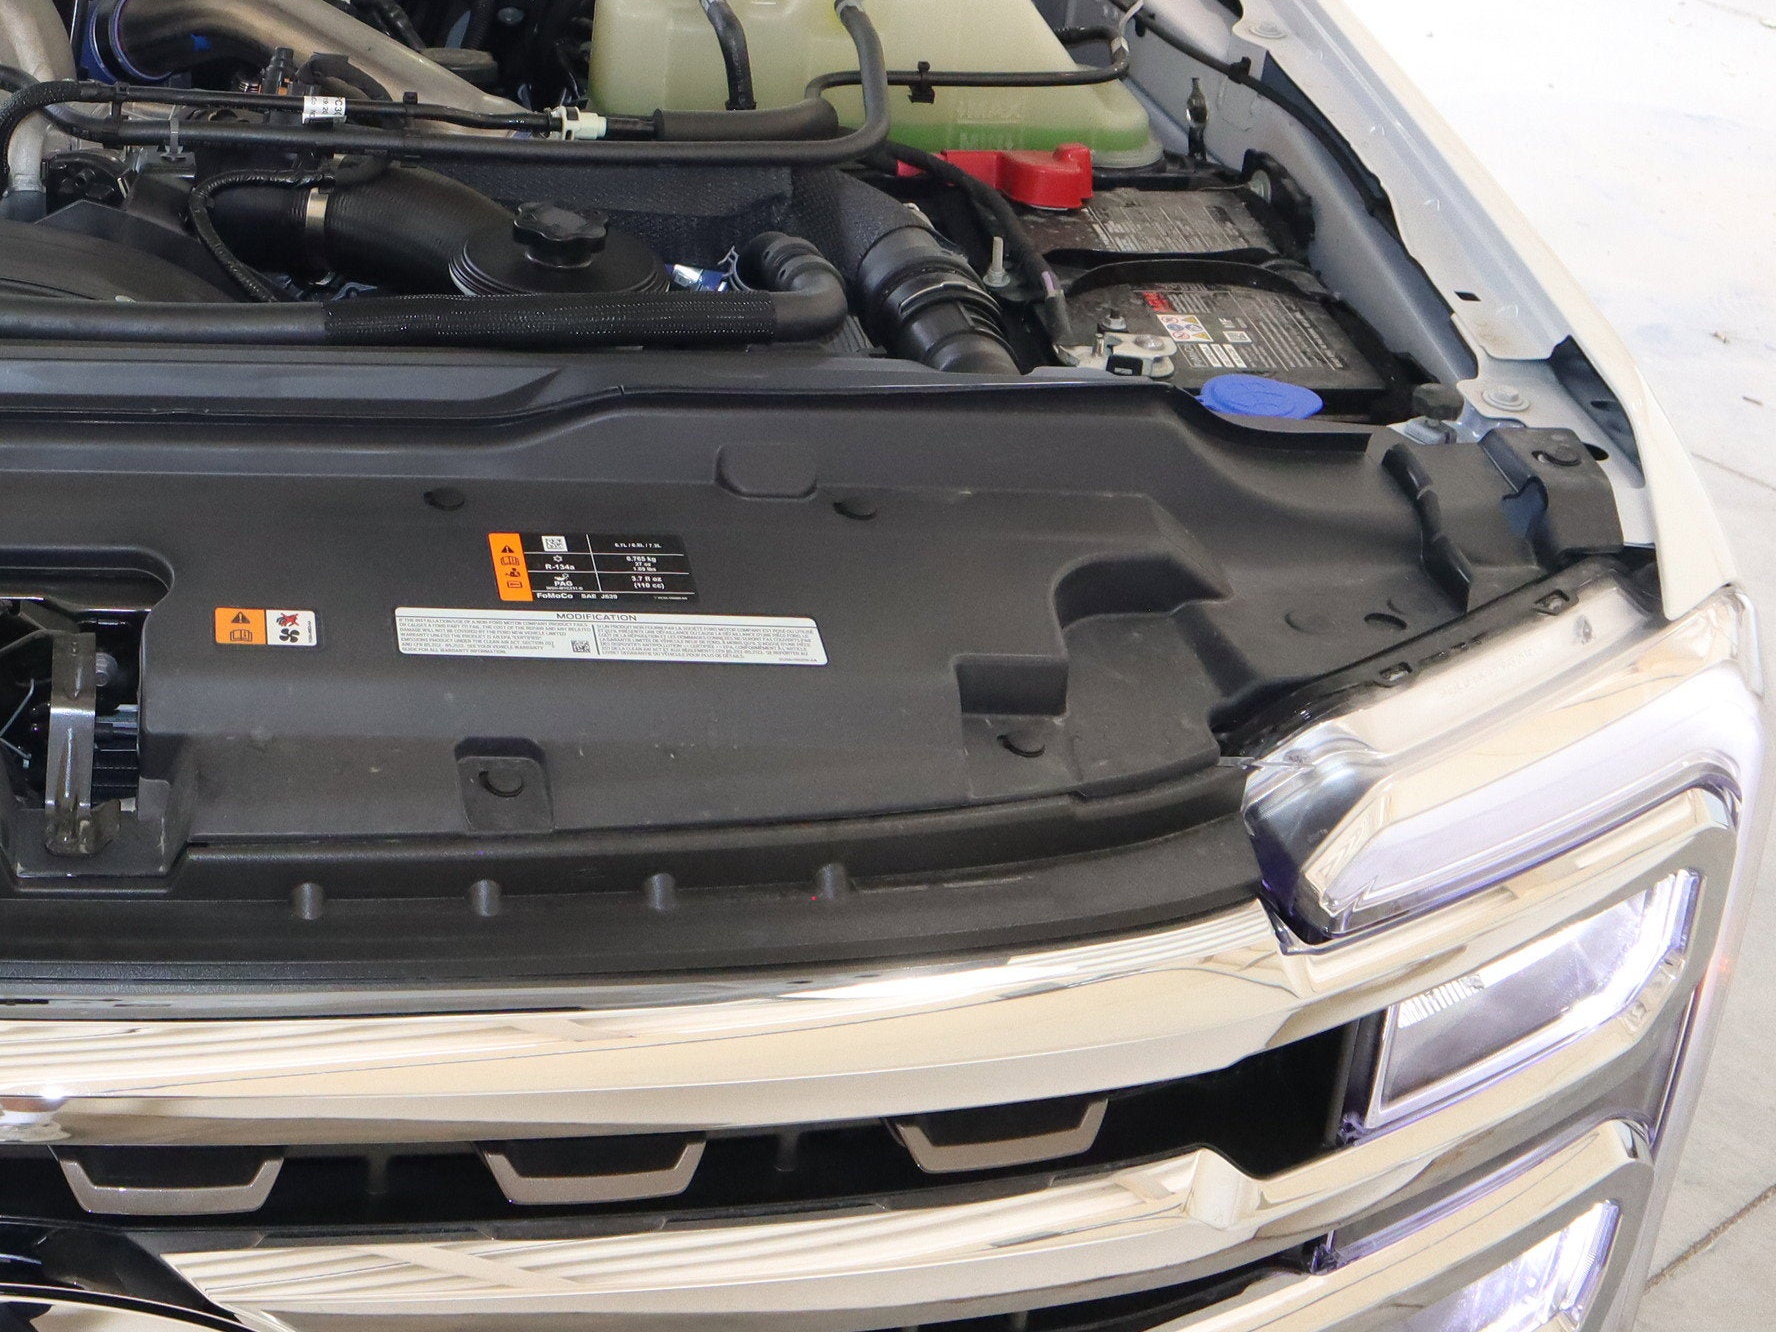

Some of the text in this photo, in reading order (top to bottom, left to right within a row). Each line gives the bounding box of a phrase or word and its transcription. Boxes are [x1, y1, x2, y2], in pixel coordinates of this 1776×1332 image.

[647, 556, 657, 564] kg
[545, 563, 576, 571] R-134a
[556, 612, 637, 621] MODIFICATION
